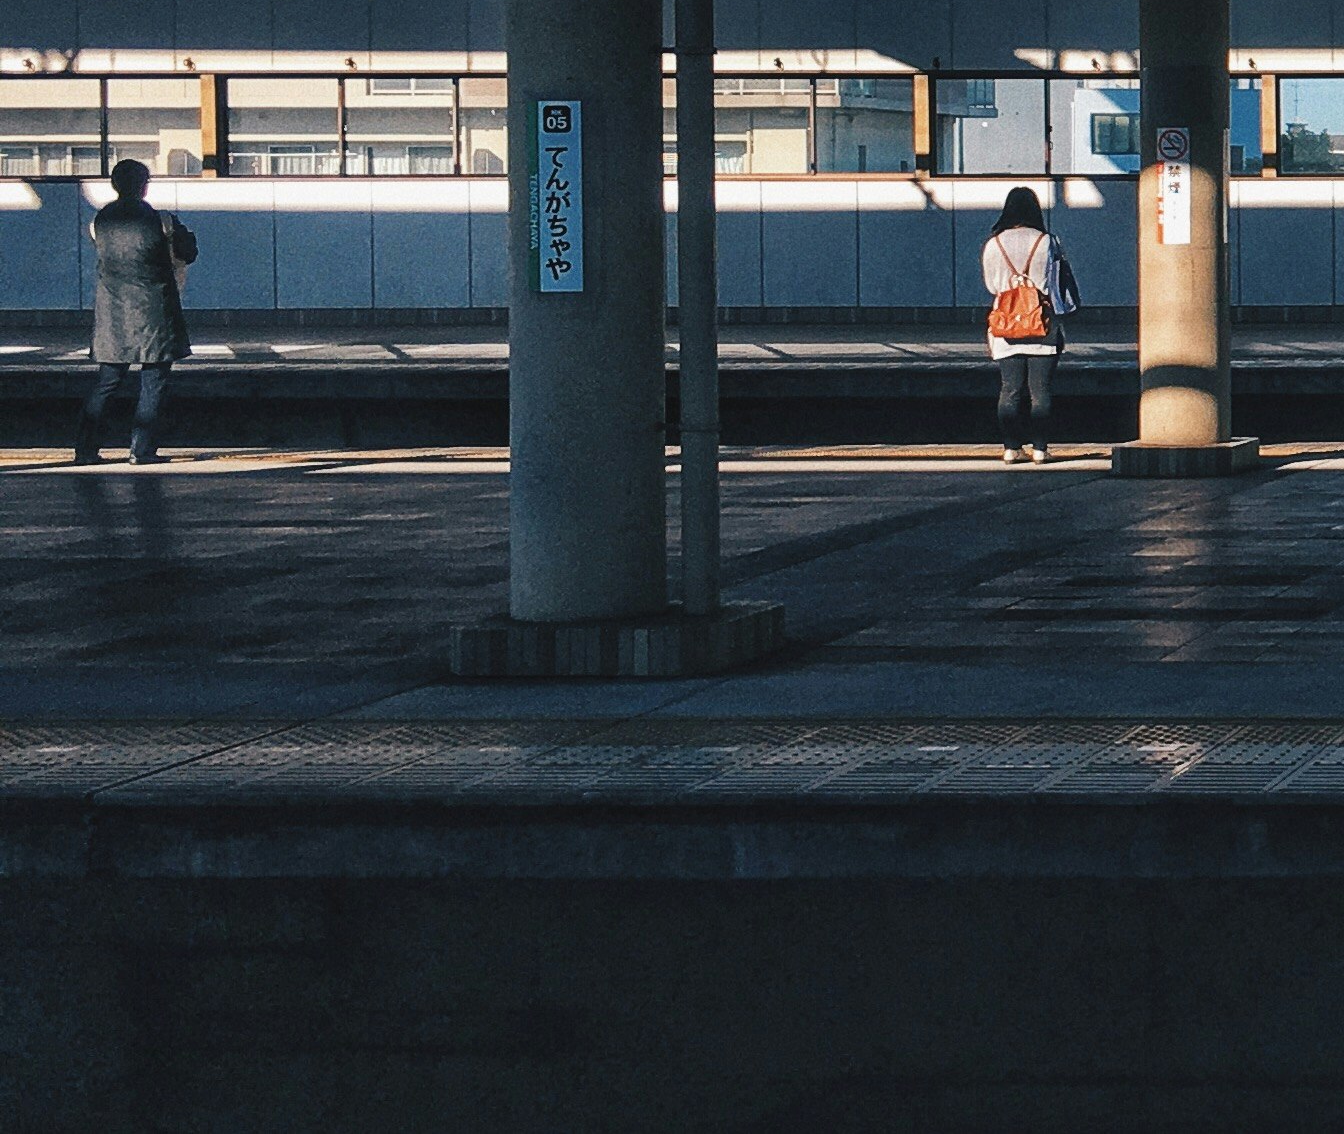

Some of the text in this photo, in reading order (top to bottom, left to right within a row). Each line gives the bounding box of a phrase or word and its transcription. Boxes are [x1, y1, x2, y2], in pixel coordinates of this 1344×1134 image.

[546, 116, 568, 130] 05
[529, 174, 540, 250] TENGACHAYA
[544, 146, 573, 281] てんがちゃや
